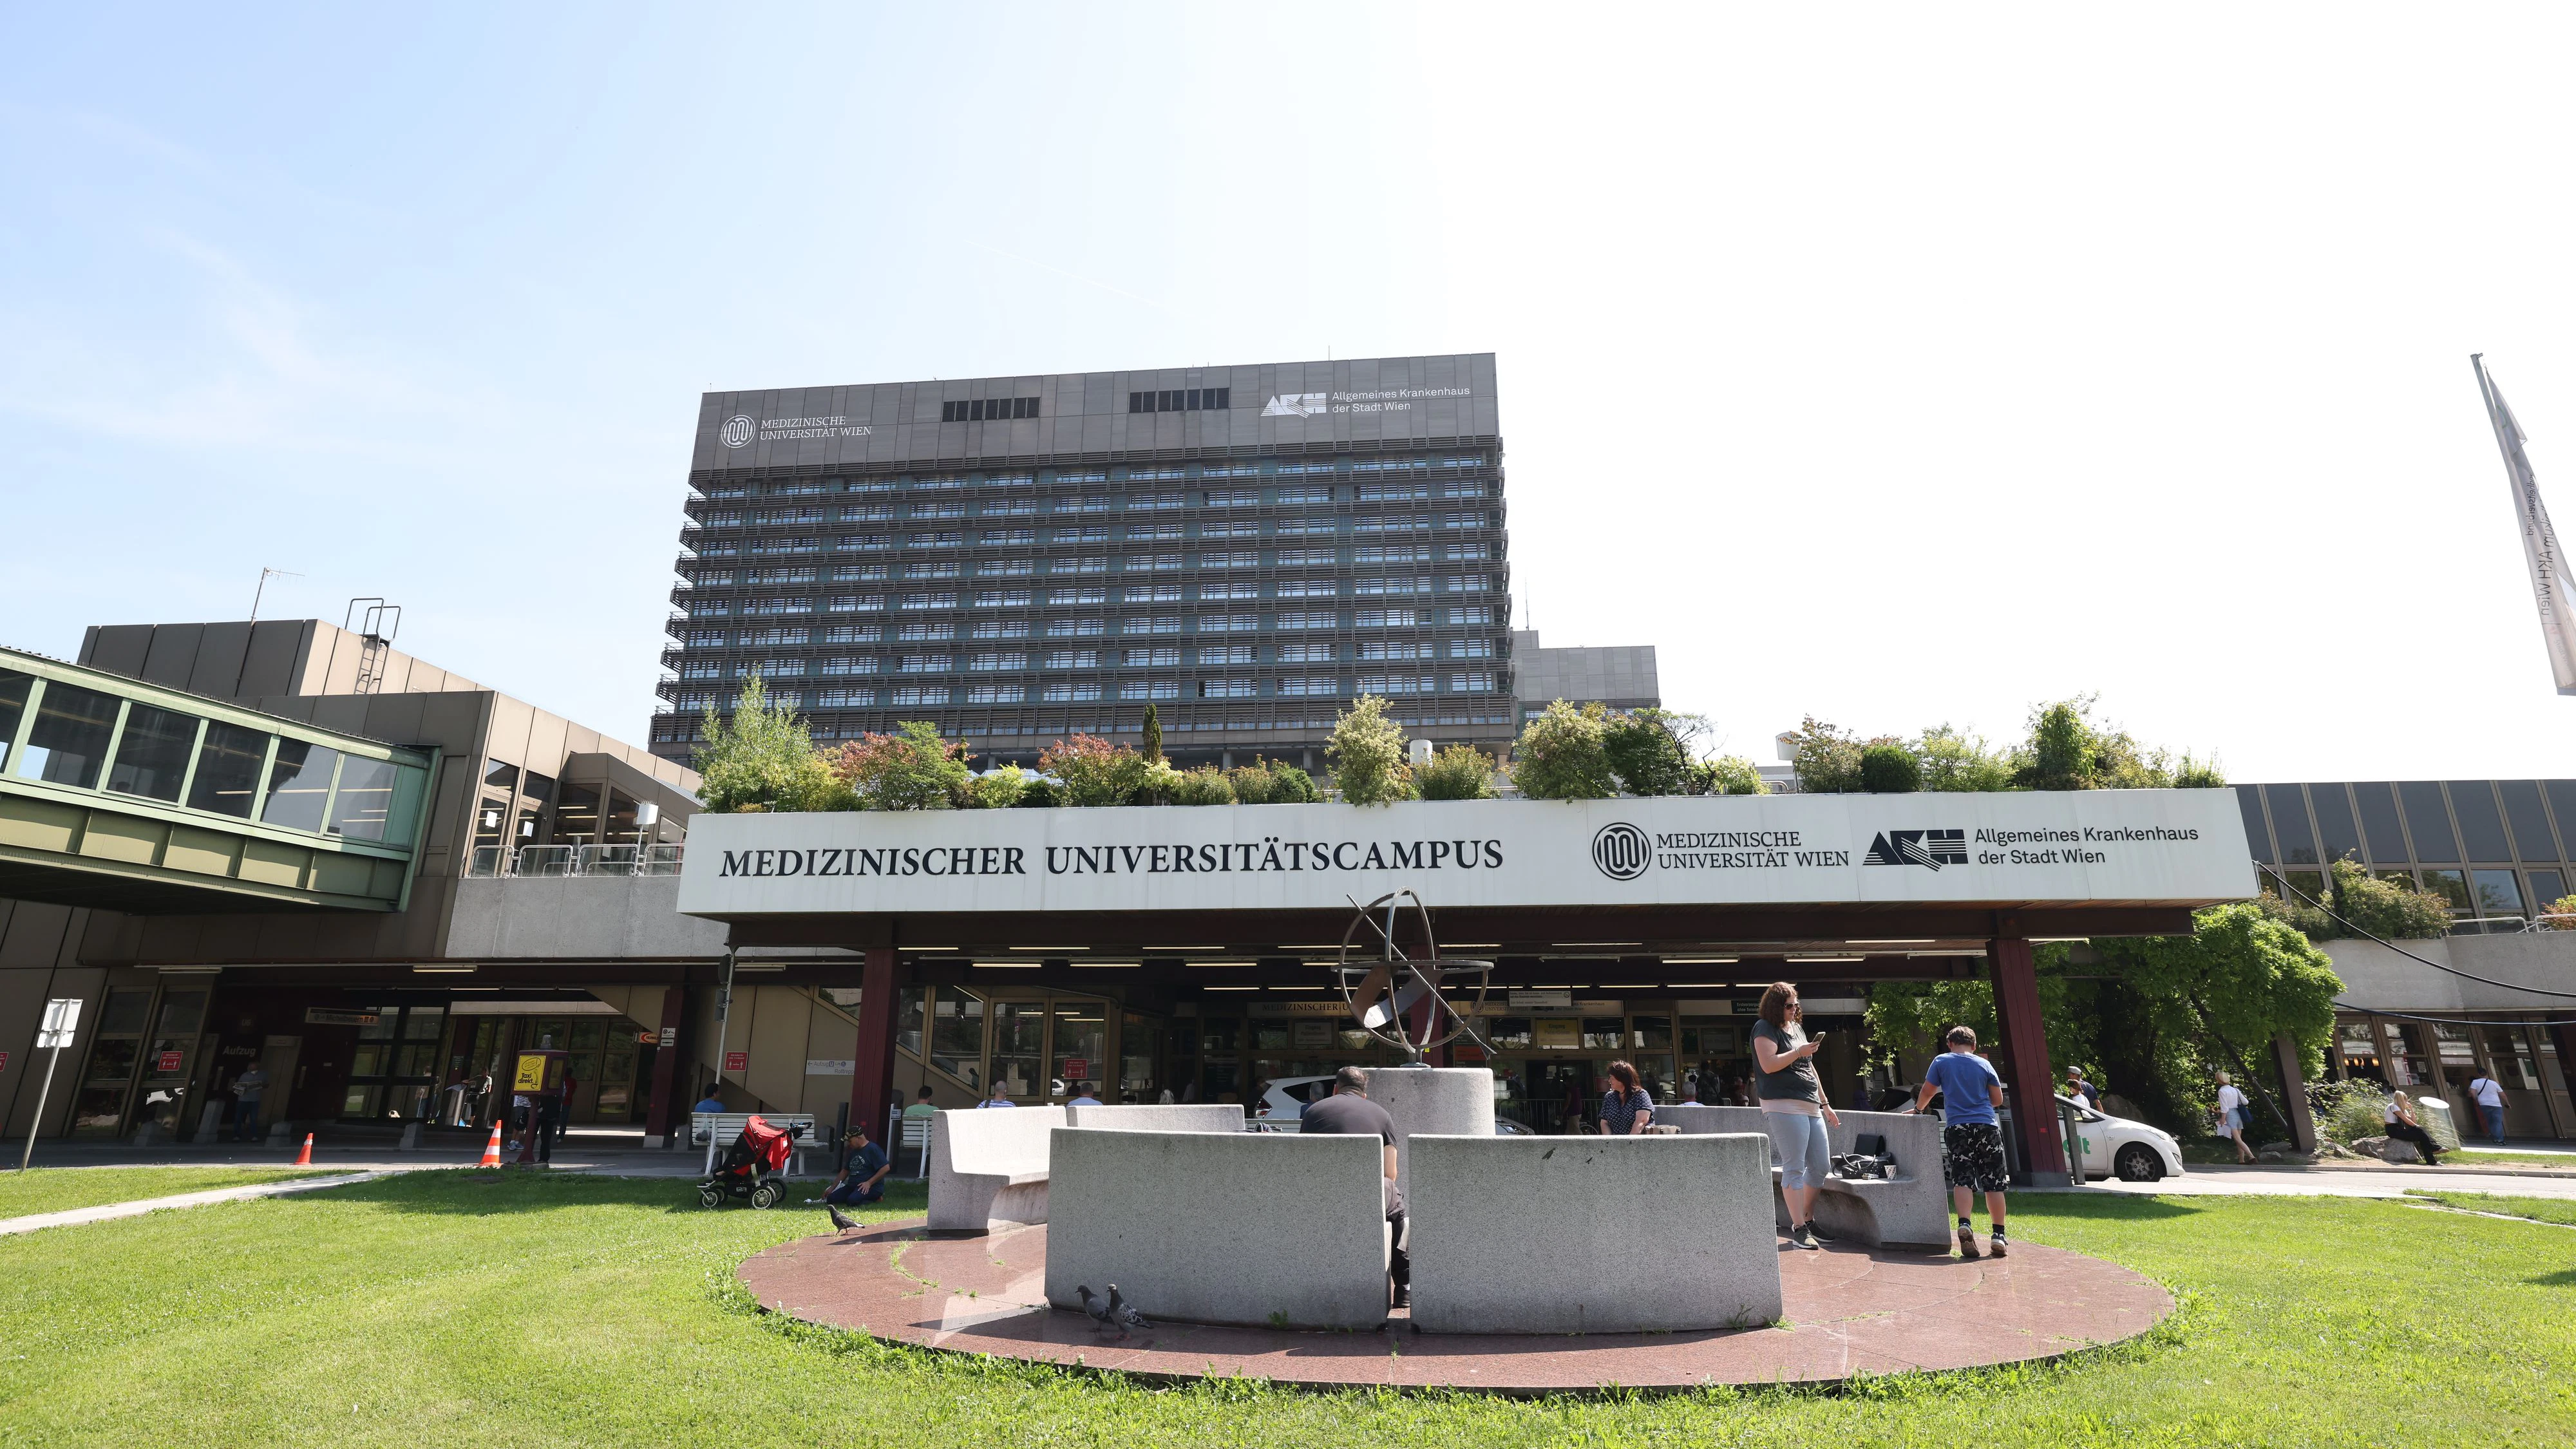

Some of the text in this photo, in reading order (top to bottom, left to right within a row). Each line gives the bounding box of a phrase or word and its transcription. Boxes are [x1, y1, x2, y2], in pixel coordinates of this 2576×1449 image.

[1332, 386, 1470, 402] Allgemeines Krankenhaus
[1332, 402, 1410, 413] der Stadt Wien
[761, 416, 846, 429] MEDIZINISCHE
[760, 426, 872, 440] UNIVERSITÄT WIEN
[1657, 831, 1801, 849] MEDIZINISCHE
[1975, 826, 2199, 846] Allgemeines Krankenhaus
[719, 837, 1504, 877] MEDIZINISCHER UNIVERSITÄTSCAMPUS
[1658, 848, 1849, 869] UNIVERSITÄT WIEN
[1978, 848, 2106, 865] der Stadt Wien
[222, 1046, 256, 1057] Aufzug
